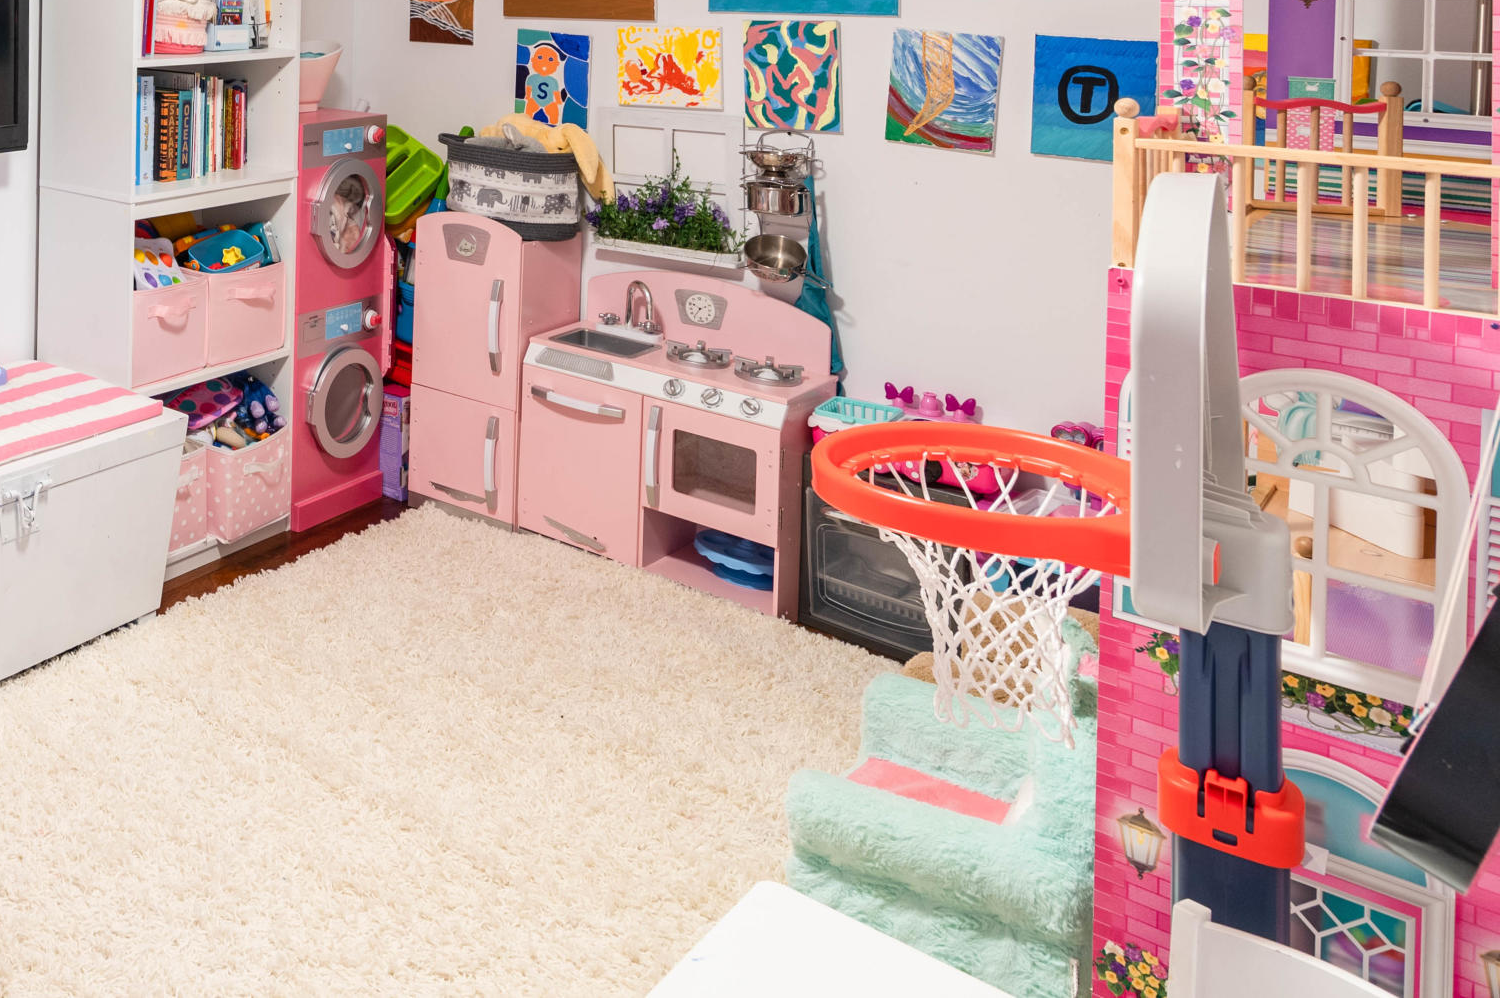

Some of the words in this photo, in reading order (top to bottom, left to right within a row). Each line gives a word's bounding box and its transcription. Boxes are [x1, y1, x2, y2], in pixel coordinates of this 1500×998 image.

[536, 81, 550, 100] S
[1071, 76, 1107, 114] T
[168, 104, 176, 170] SAFARI
[181, 104, 191, 165] OCEAN
